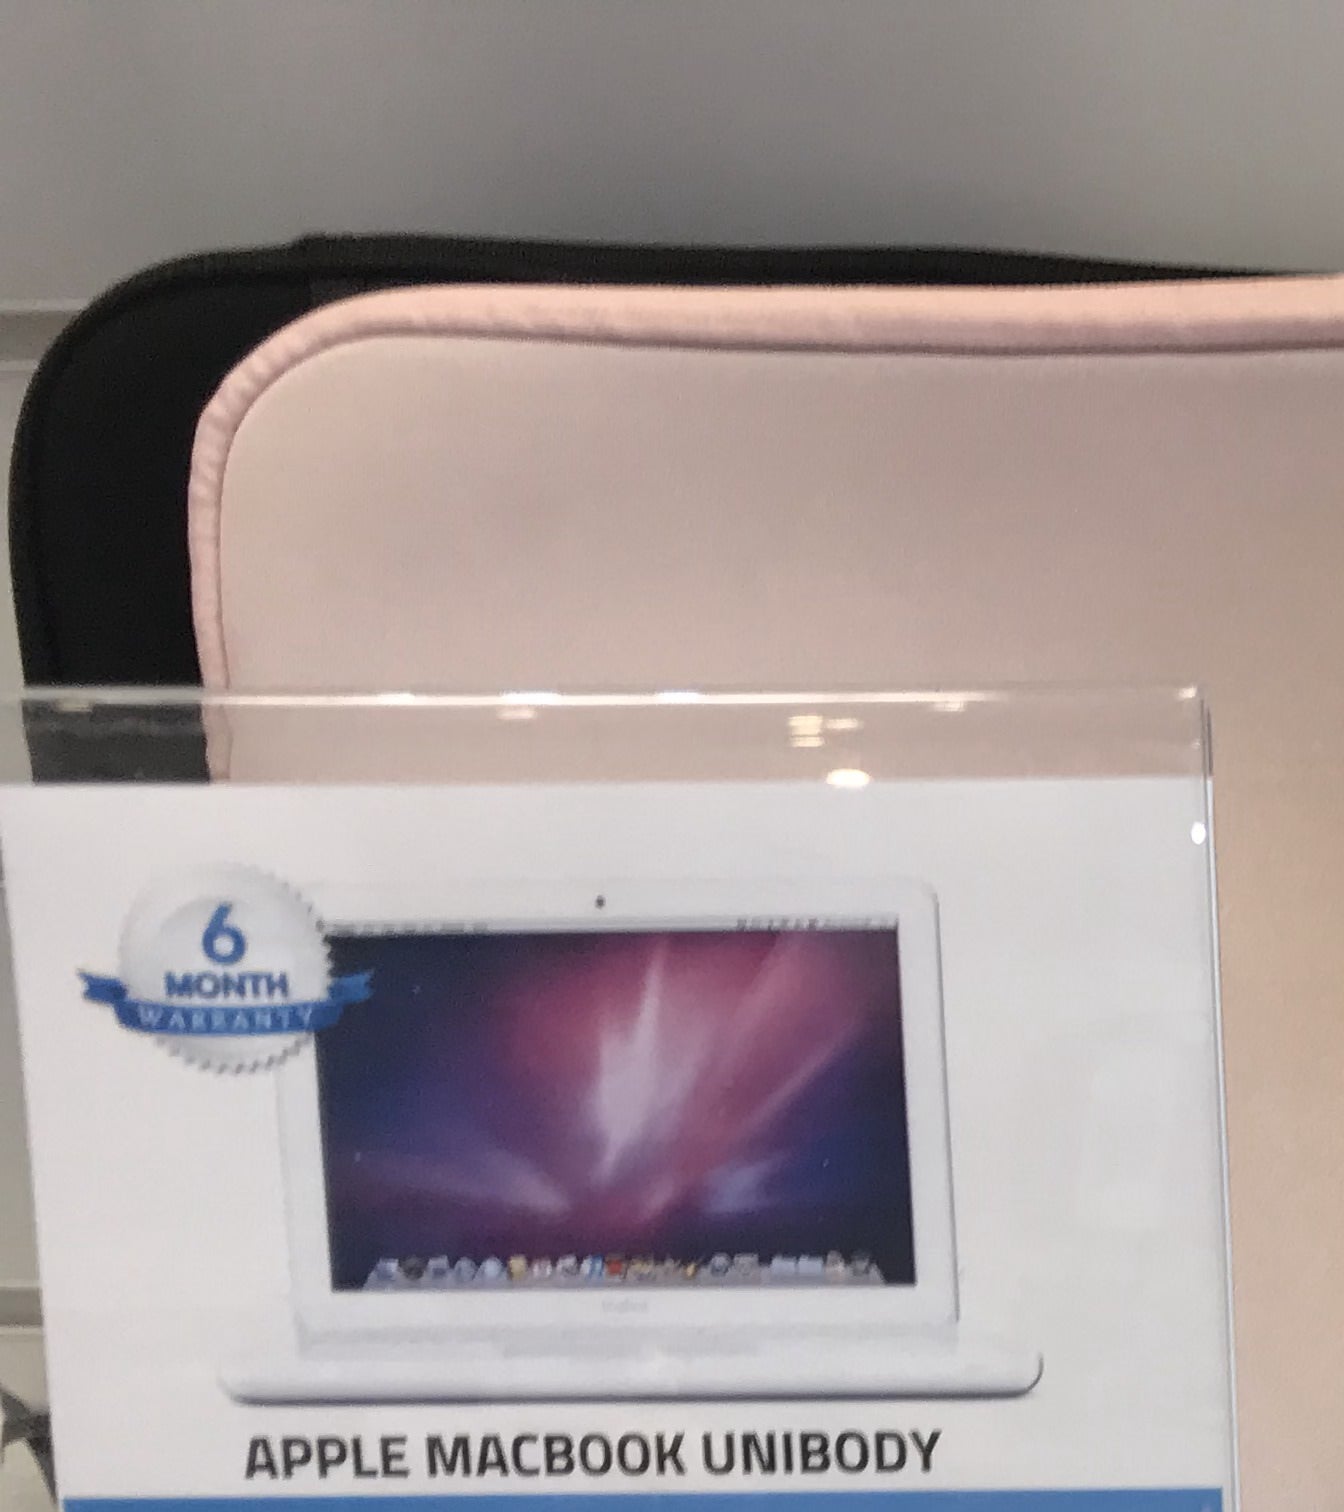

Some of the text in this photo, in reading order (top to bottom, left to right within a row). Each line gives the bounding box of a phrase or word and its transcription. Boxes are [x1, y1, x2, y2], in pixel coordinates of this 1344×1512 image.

[202, 902, 247, 964] 6
[164, 971, 289, 999] MONTH
[134, 1001, 315, 1029] WARRANTY
[244, 1429, 942, 1480] APPLE MACBOOK UNIBODY
